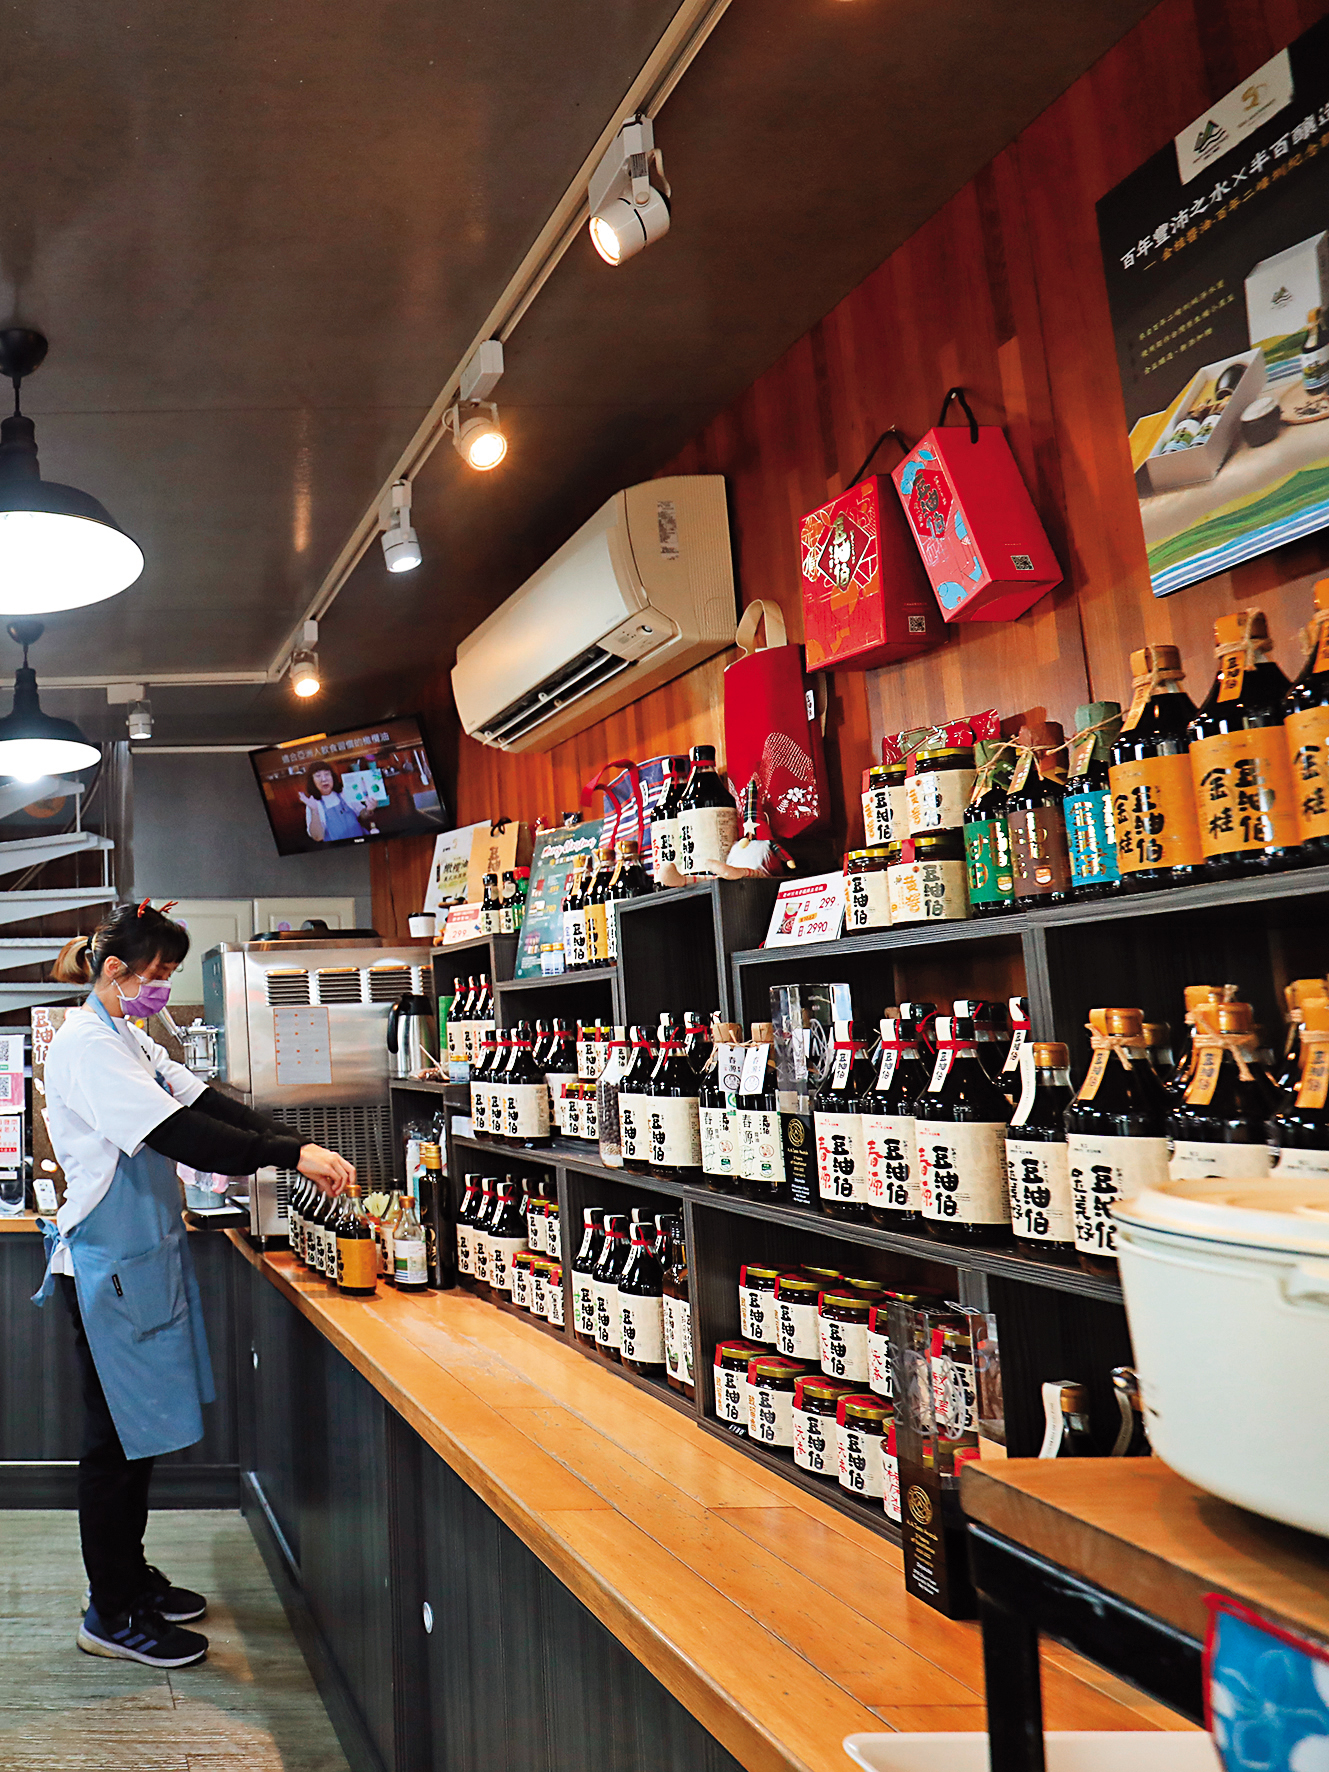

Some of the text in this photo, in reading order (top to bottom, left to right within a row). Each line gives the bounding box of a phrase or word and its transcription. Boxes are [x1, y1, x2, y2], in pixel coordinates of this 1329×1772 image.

[806, 921, 828, 935] 2990
[818, 896, 836, 909] 299
[831, 1134, 855, 1198] 豆油伯
[883, 1138, 911, 1206] 豆油伯
[932, 1145, 960, 1217] 豆油伯
[1021, 1157, 1052, 1235] 豆油伯
[749, 1292, 765, 1339] 豆油伯
[780, 1304, 796, 1354] 豆油伯
[829, 1323, 847, 1376] 豆油伯
[724, 1372, 741, 1420] 豆油伯
[758, 1390, 776, 1441] 豆油伯
[806, 1416, 826, 1470] 豆油伯
[846, 1432, 867, 1491] 豆油伯
